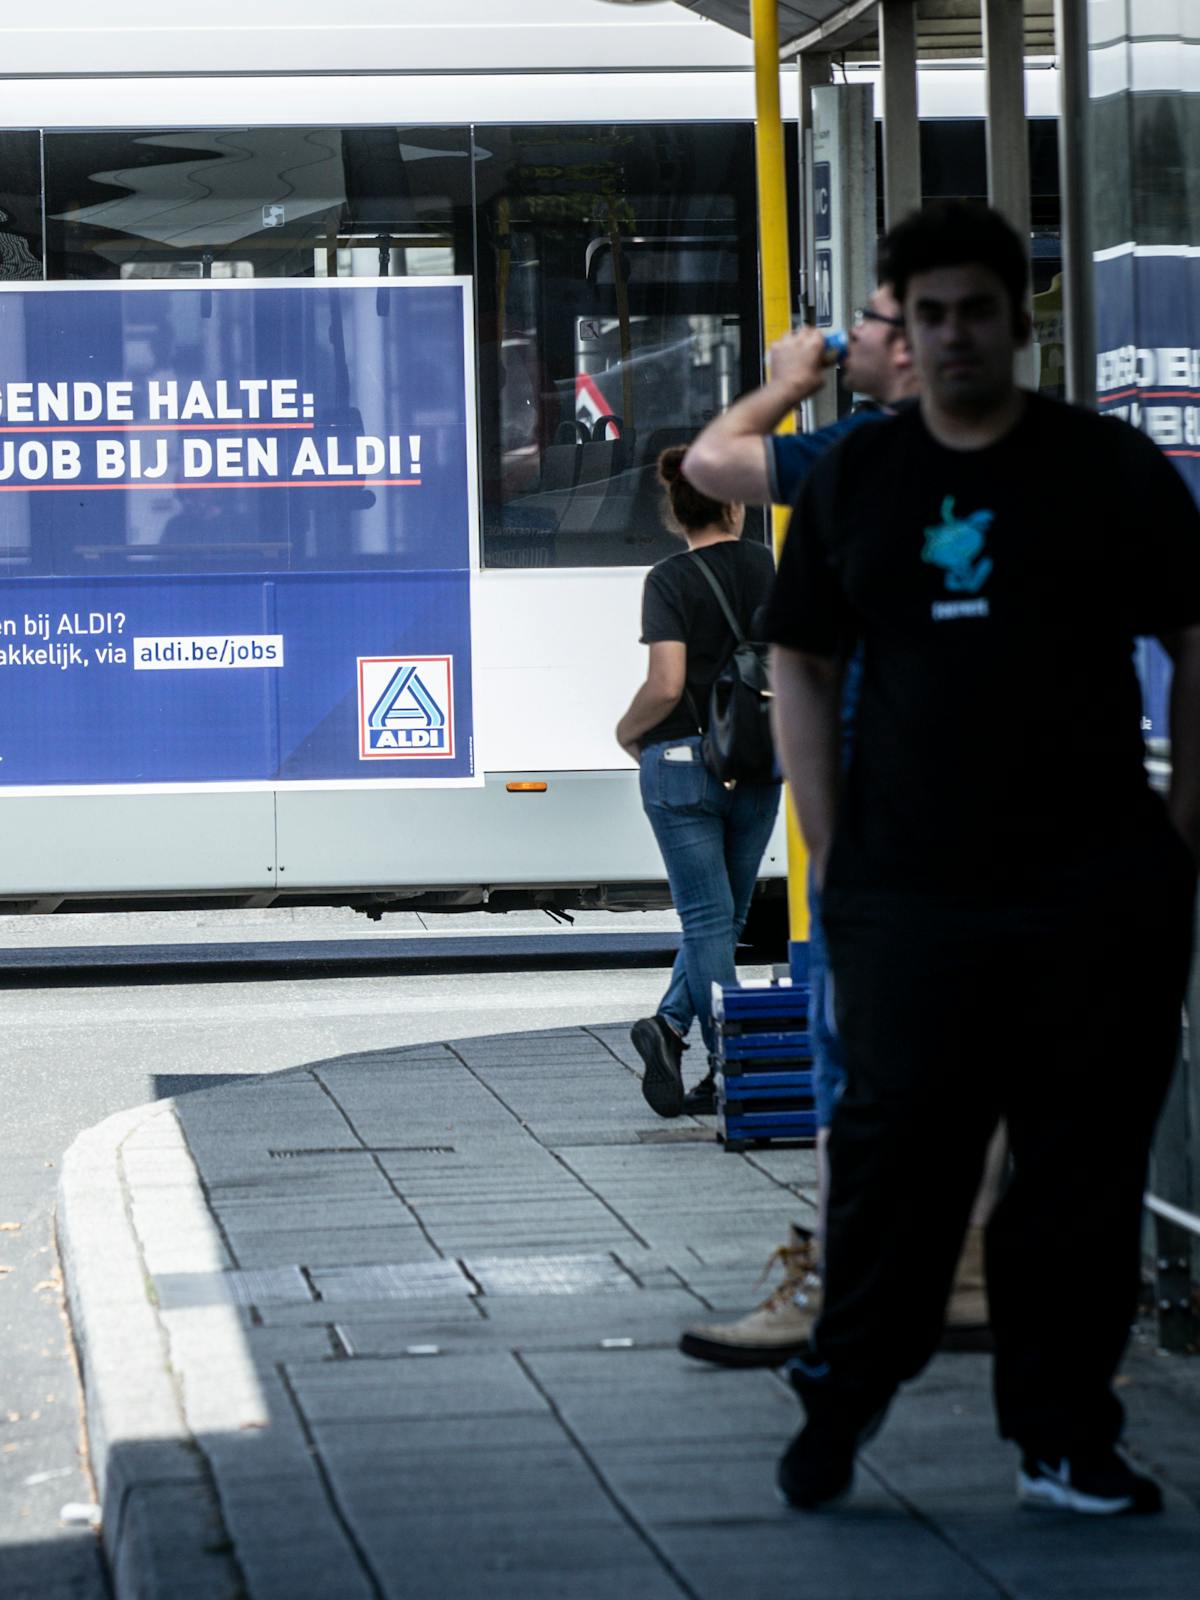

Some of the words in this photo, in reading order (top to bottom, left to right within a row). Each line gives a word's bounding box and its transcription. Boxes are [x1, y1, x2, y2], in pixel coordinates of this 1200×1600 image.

[148, 379, 314, 420] HALTE:
[96, 438, 168, 479] BIJ
[183, 437, 278, 478] DEN
[291, 435, 421, 476] ALDI!
[24, 613, 50, 641] bij
[57, 612, 126, 636] ALDI?
[95, 642, 127, 664] via
[140, 639, 277, 665] aldi.be/jobs
[375, 730, 439, 748] ALDI
